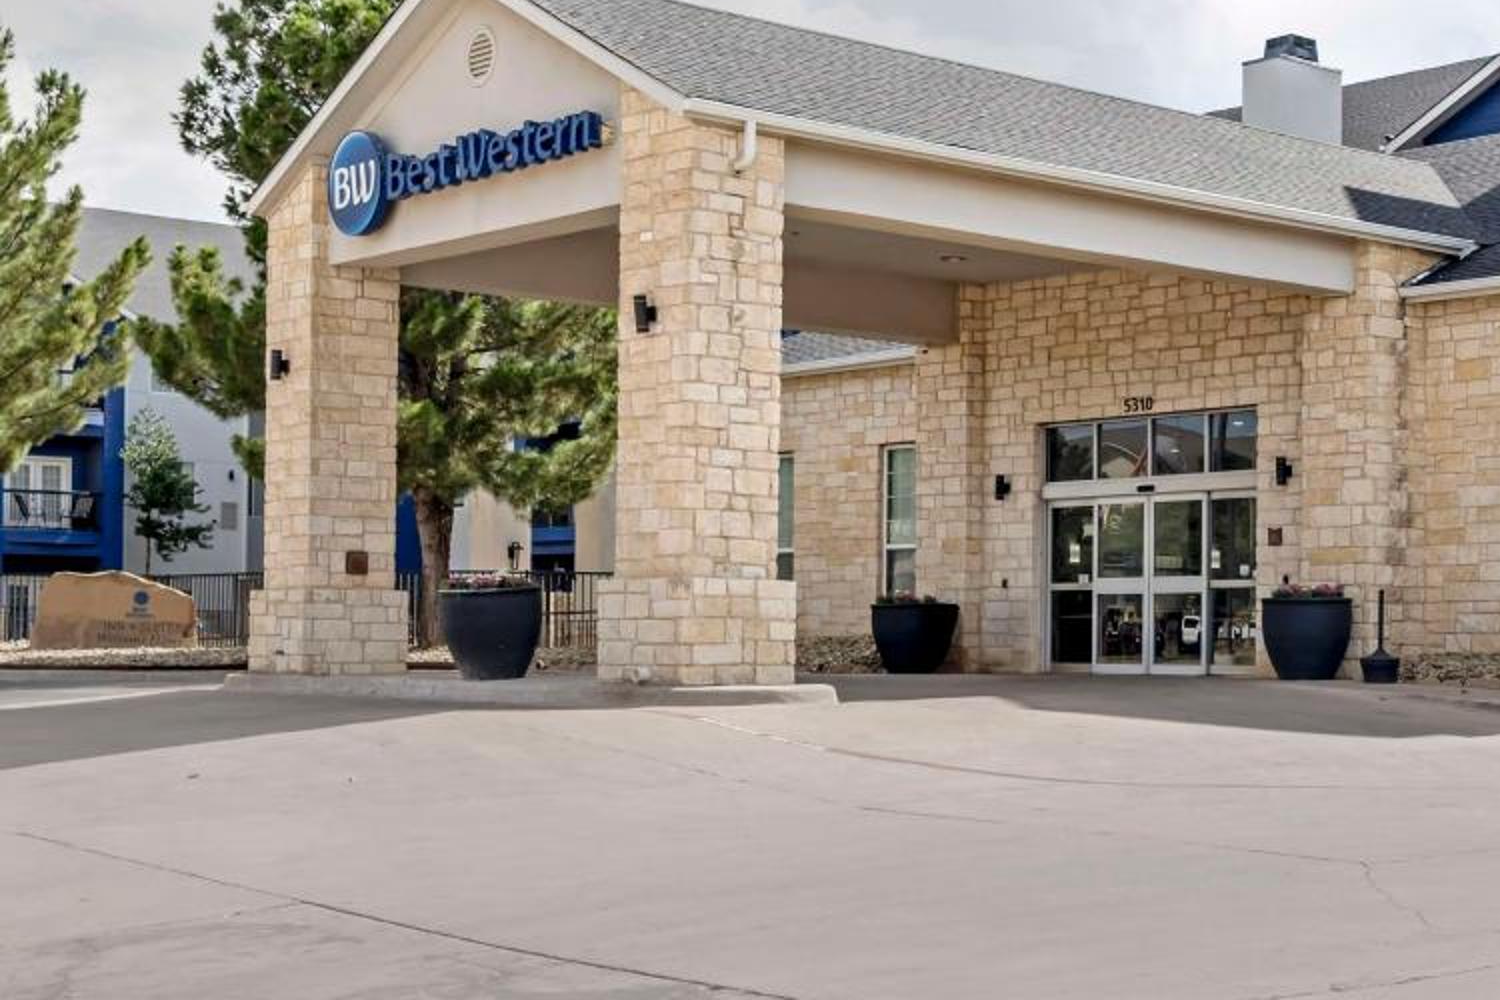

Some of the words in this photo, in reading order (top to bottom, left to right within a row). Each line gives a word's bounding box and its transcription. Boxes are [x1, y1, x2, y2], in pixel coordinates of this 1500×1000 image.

[384, 143, 454, 201] Best
[453, 110, 602, 183] Western
[332, 158, 376, 211] BW
[1123, 396, 1153, 412] 5310
